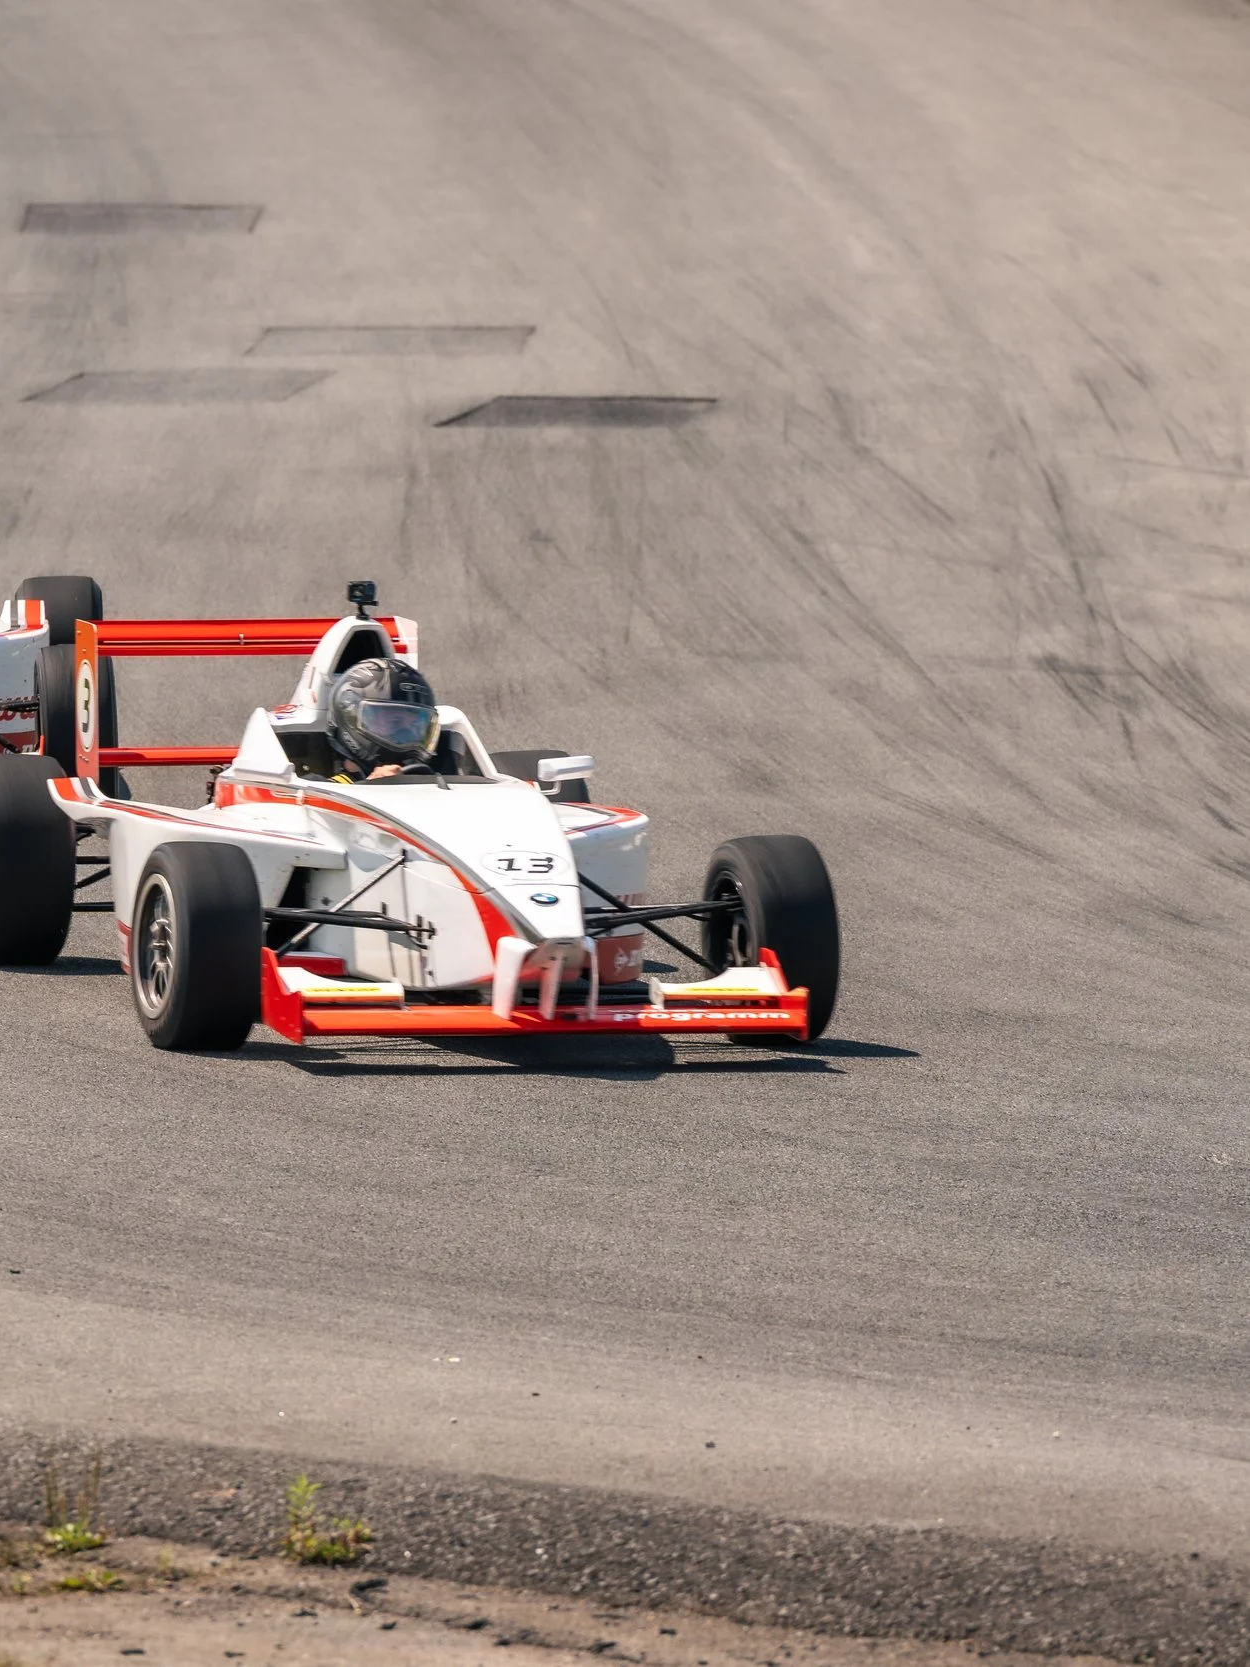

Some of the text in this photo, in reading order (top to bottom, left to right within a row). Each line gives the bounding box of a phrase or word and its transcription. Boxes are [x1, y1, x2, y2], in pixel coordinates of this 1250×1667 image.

[81, 677, 91, 734] 3
[497, 856, 554, 874] 13
[613, 1011, 791, 1022] programm
